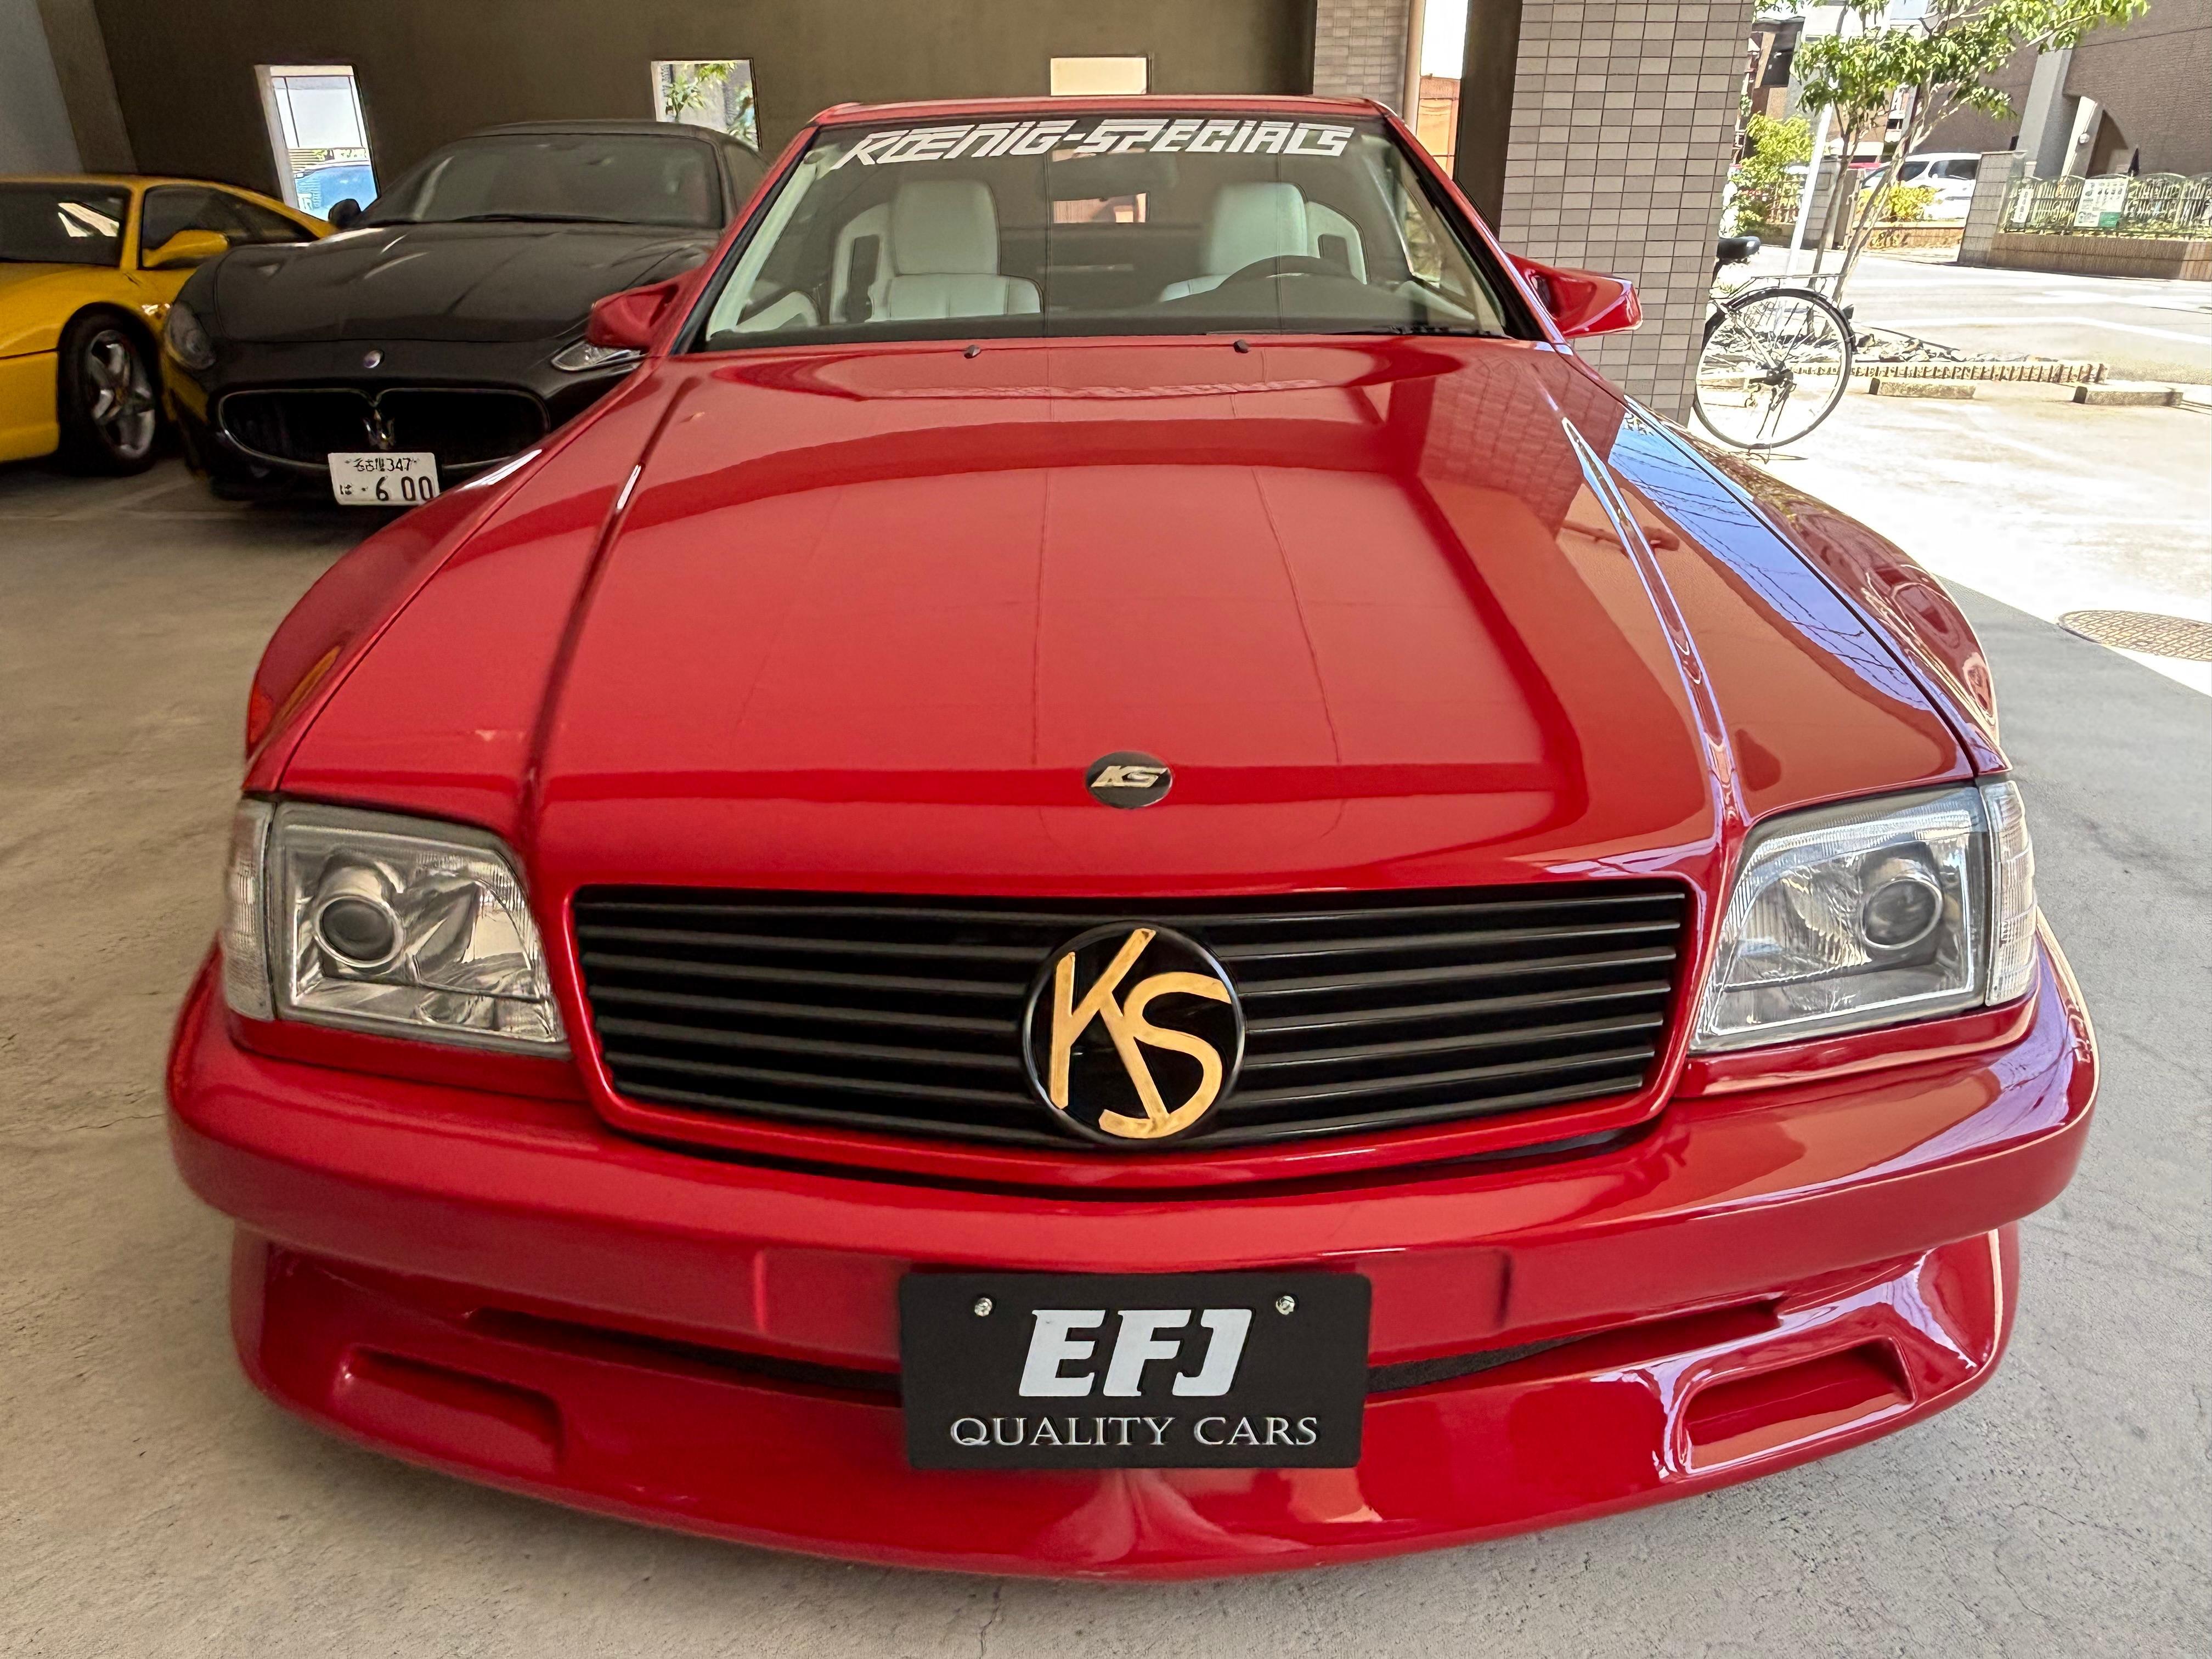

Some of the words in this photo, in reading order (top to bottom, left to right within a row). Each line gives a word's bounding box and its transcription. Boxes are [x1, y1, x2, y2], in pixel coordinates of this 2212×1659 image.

[1090, 765, 1168, 788] KS
[1049, 928, 1232, 1139] KS
[1019, 1308, 1254, 1397] EFJ
[950, 1416, 1176, 1446] QUALITY
[1193, 1416, 1319, 1446] CARS
